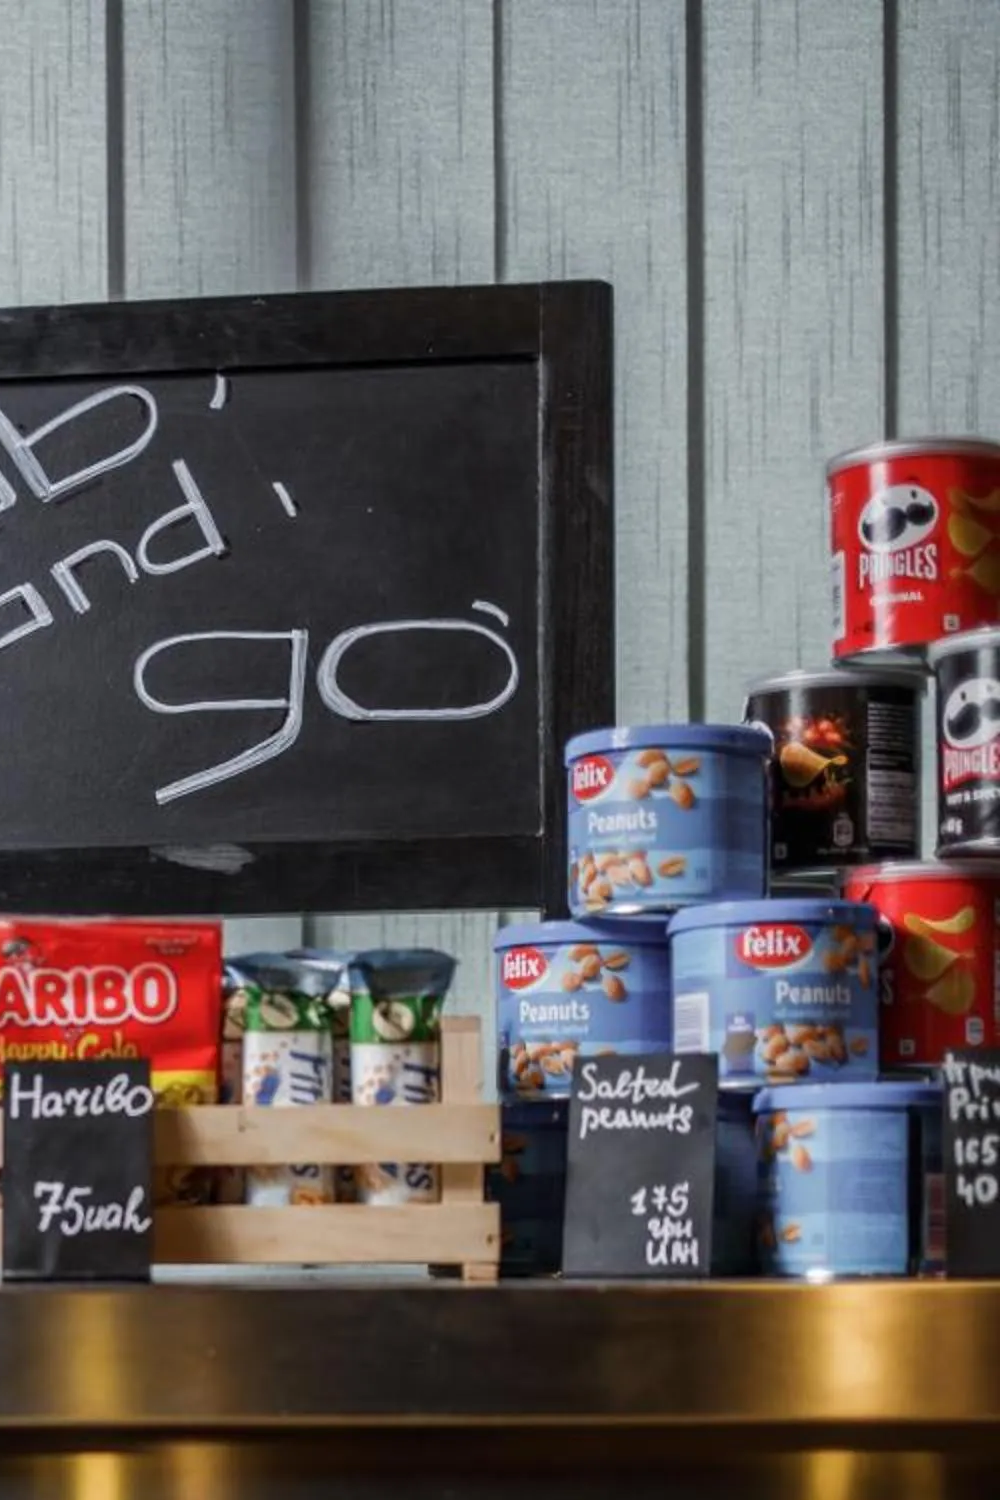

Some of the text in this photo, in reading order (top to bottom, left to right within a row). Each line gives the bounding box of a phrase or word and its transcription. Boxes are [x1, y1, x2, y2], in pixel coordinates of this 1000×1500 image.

[134, 618, 518, 804] go
[943, 742, 1000, 795] PRINGLE
[588, 807, 658, 833] Peanuts
[775, 980, 852, 1005] Peanuts
[519, 1000, 590, 1023] Peanuts
[10, 1072, 154, 1119] Haribo
[577, 1060, 700, 1104] Salted
[579, 1103, 694, 1140] peanuts
[630, 1181, 690, 1217] 175
